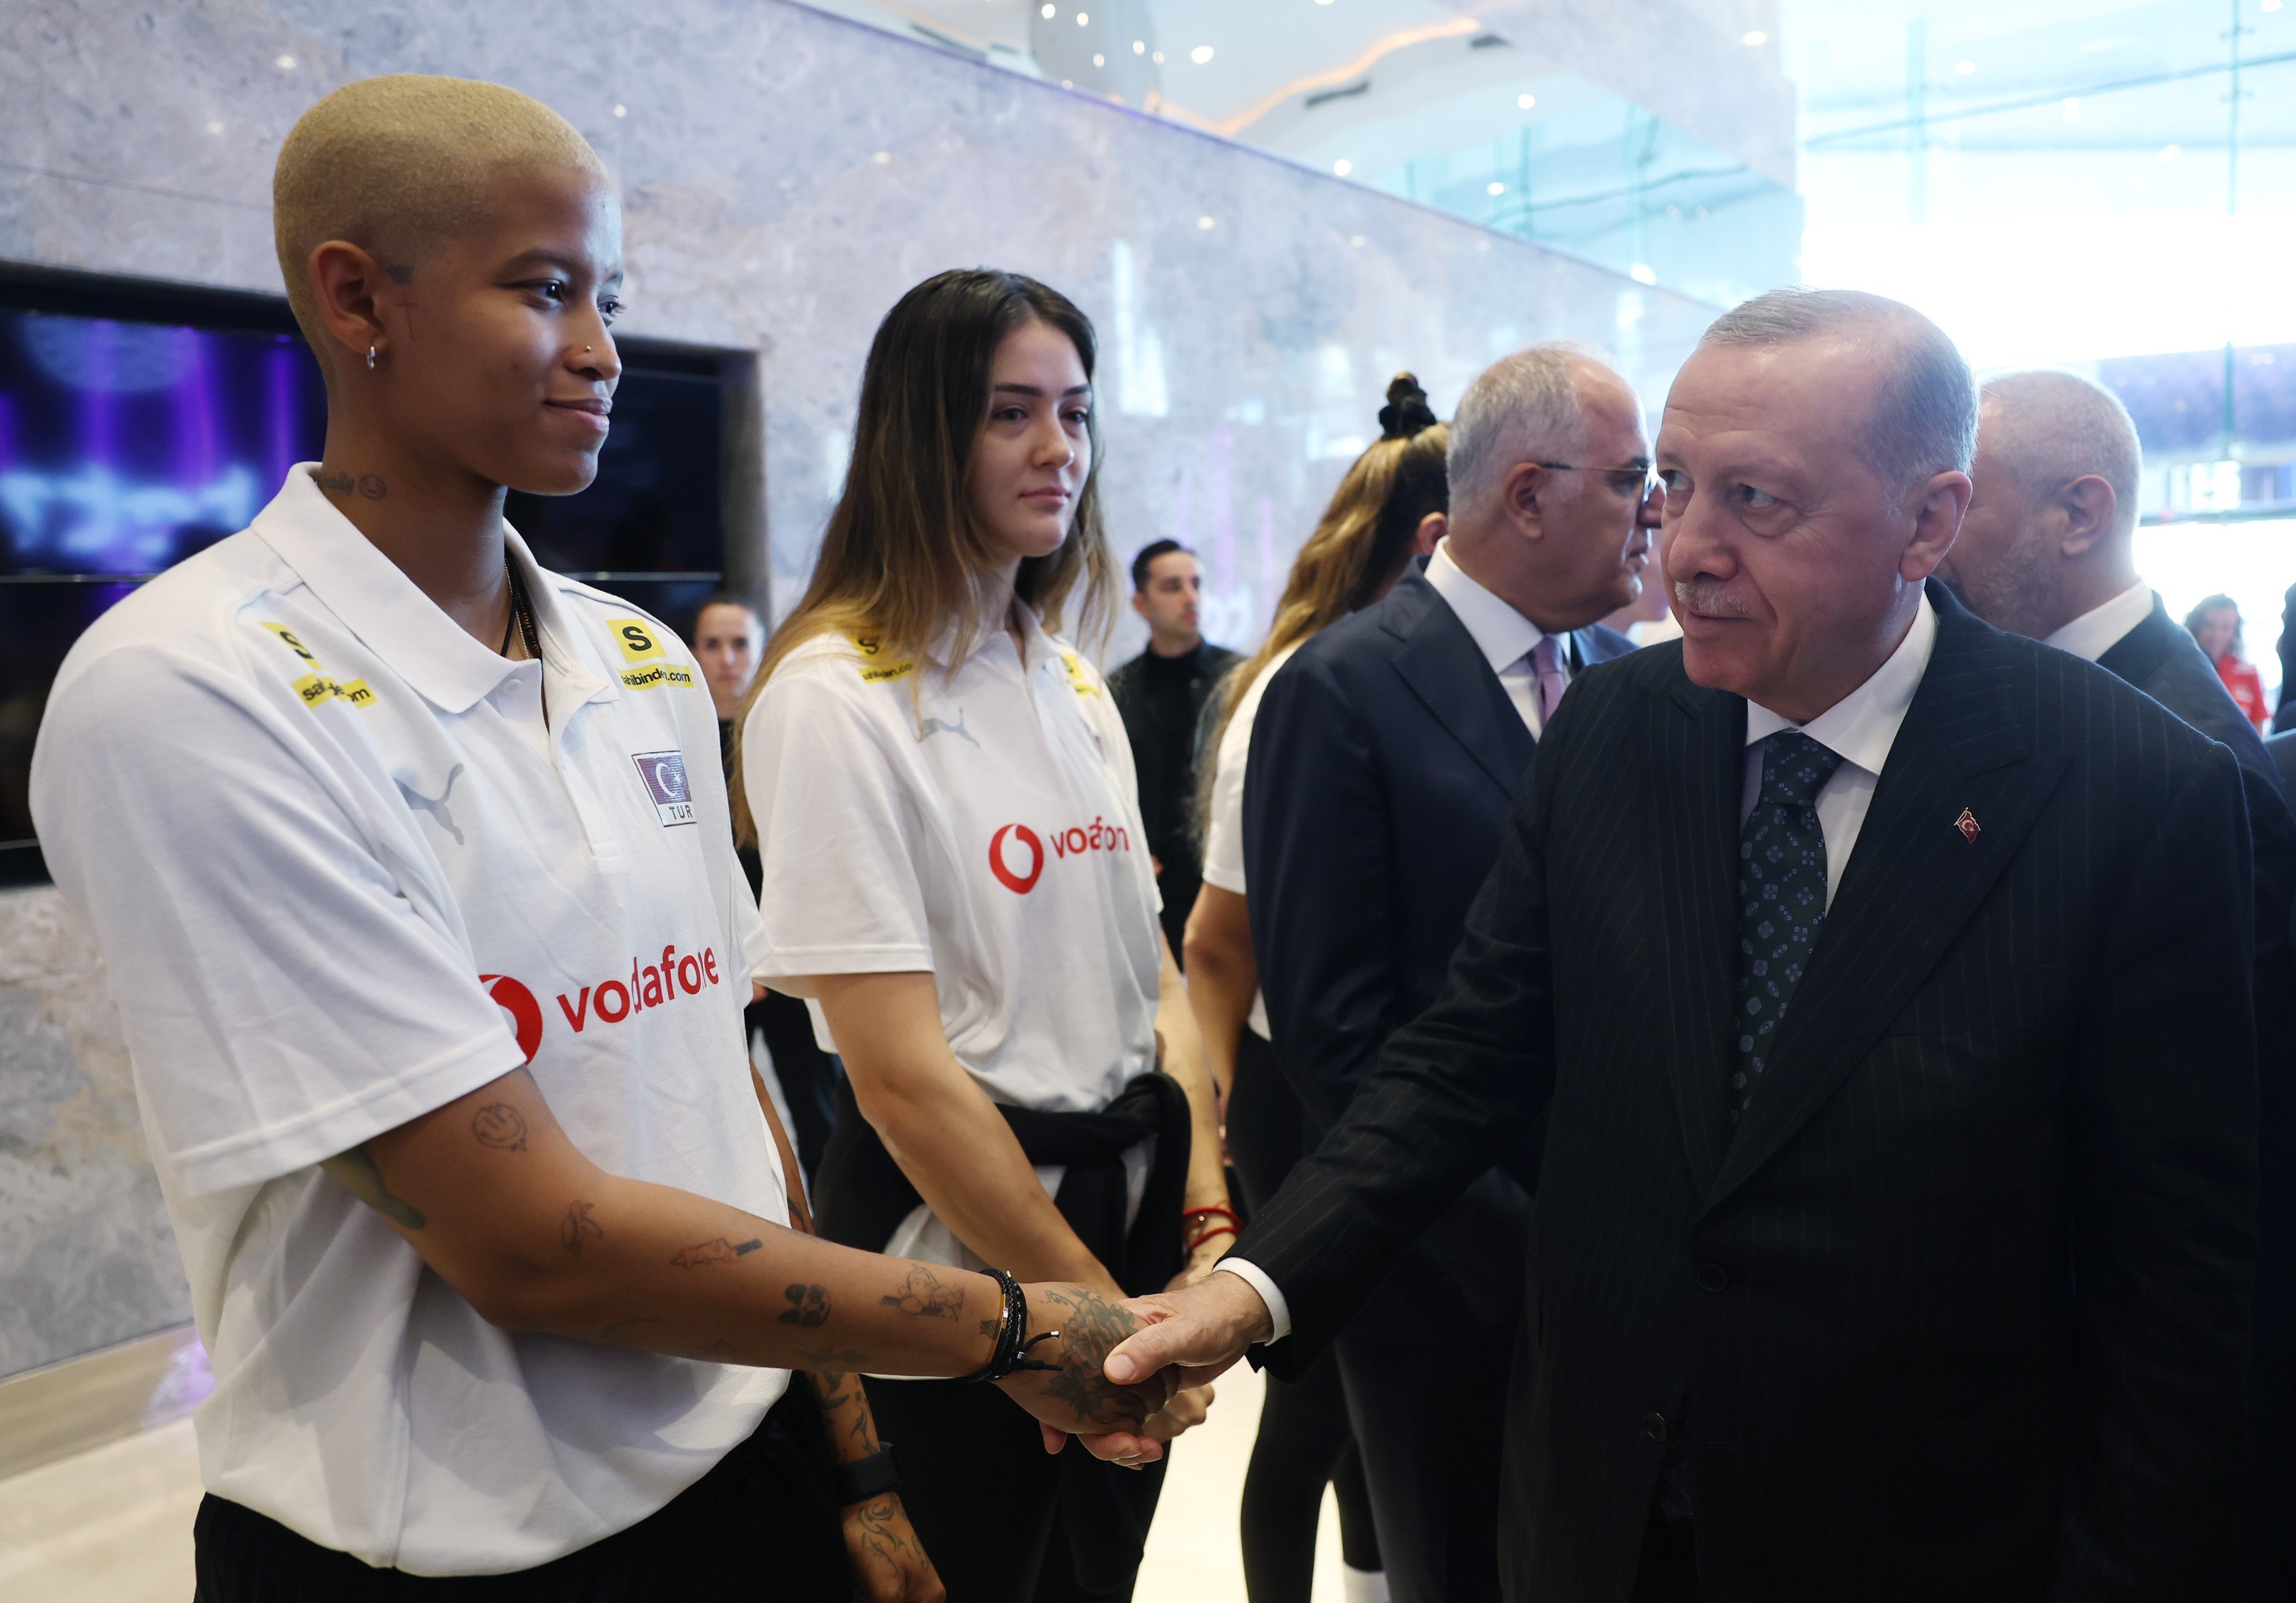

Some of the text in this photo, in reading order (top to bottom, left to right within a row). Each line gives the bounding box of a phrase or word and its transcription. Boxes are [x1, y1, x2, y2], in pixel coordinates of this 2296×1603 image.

[279, 630, 314, 659] S
[622, 626, 652, 651] S
[669, 805, 692, 820] TUR
